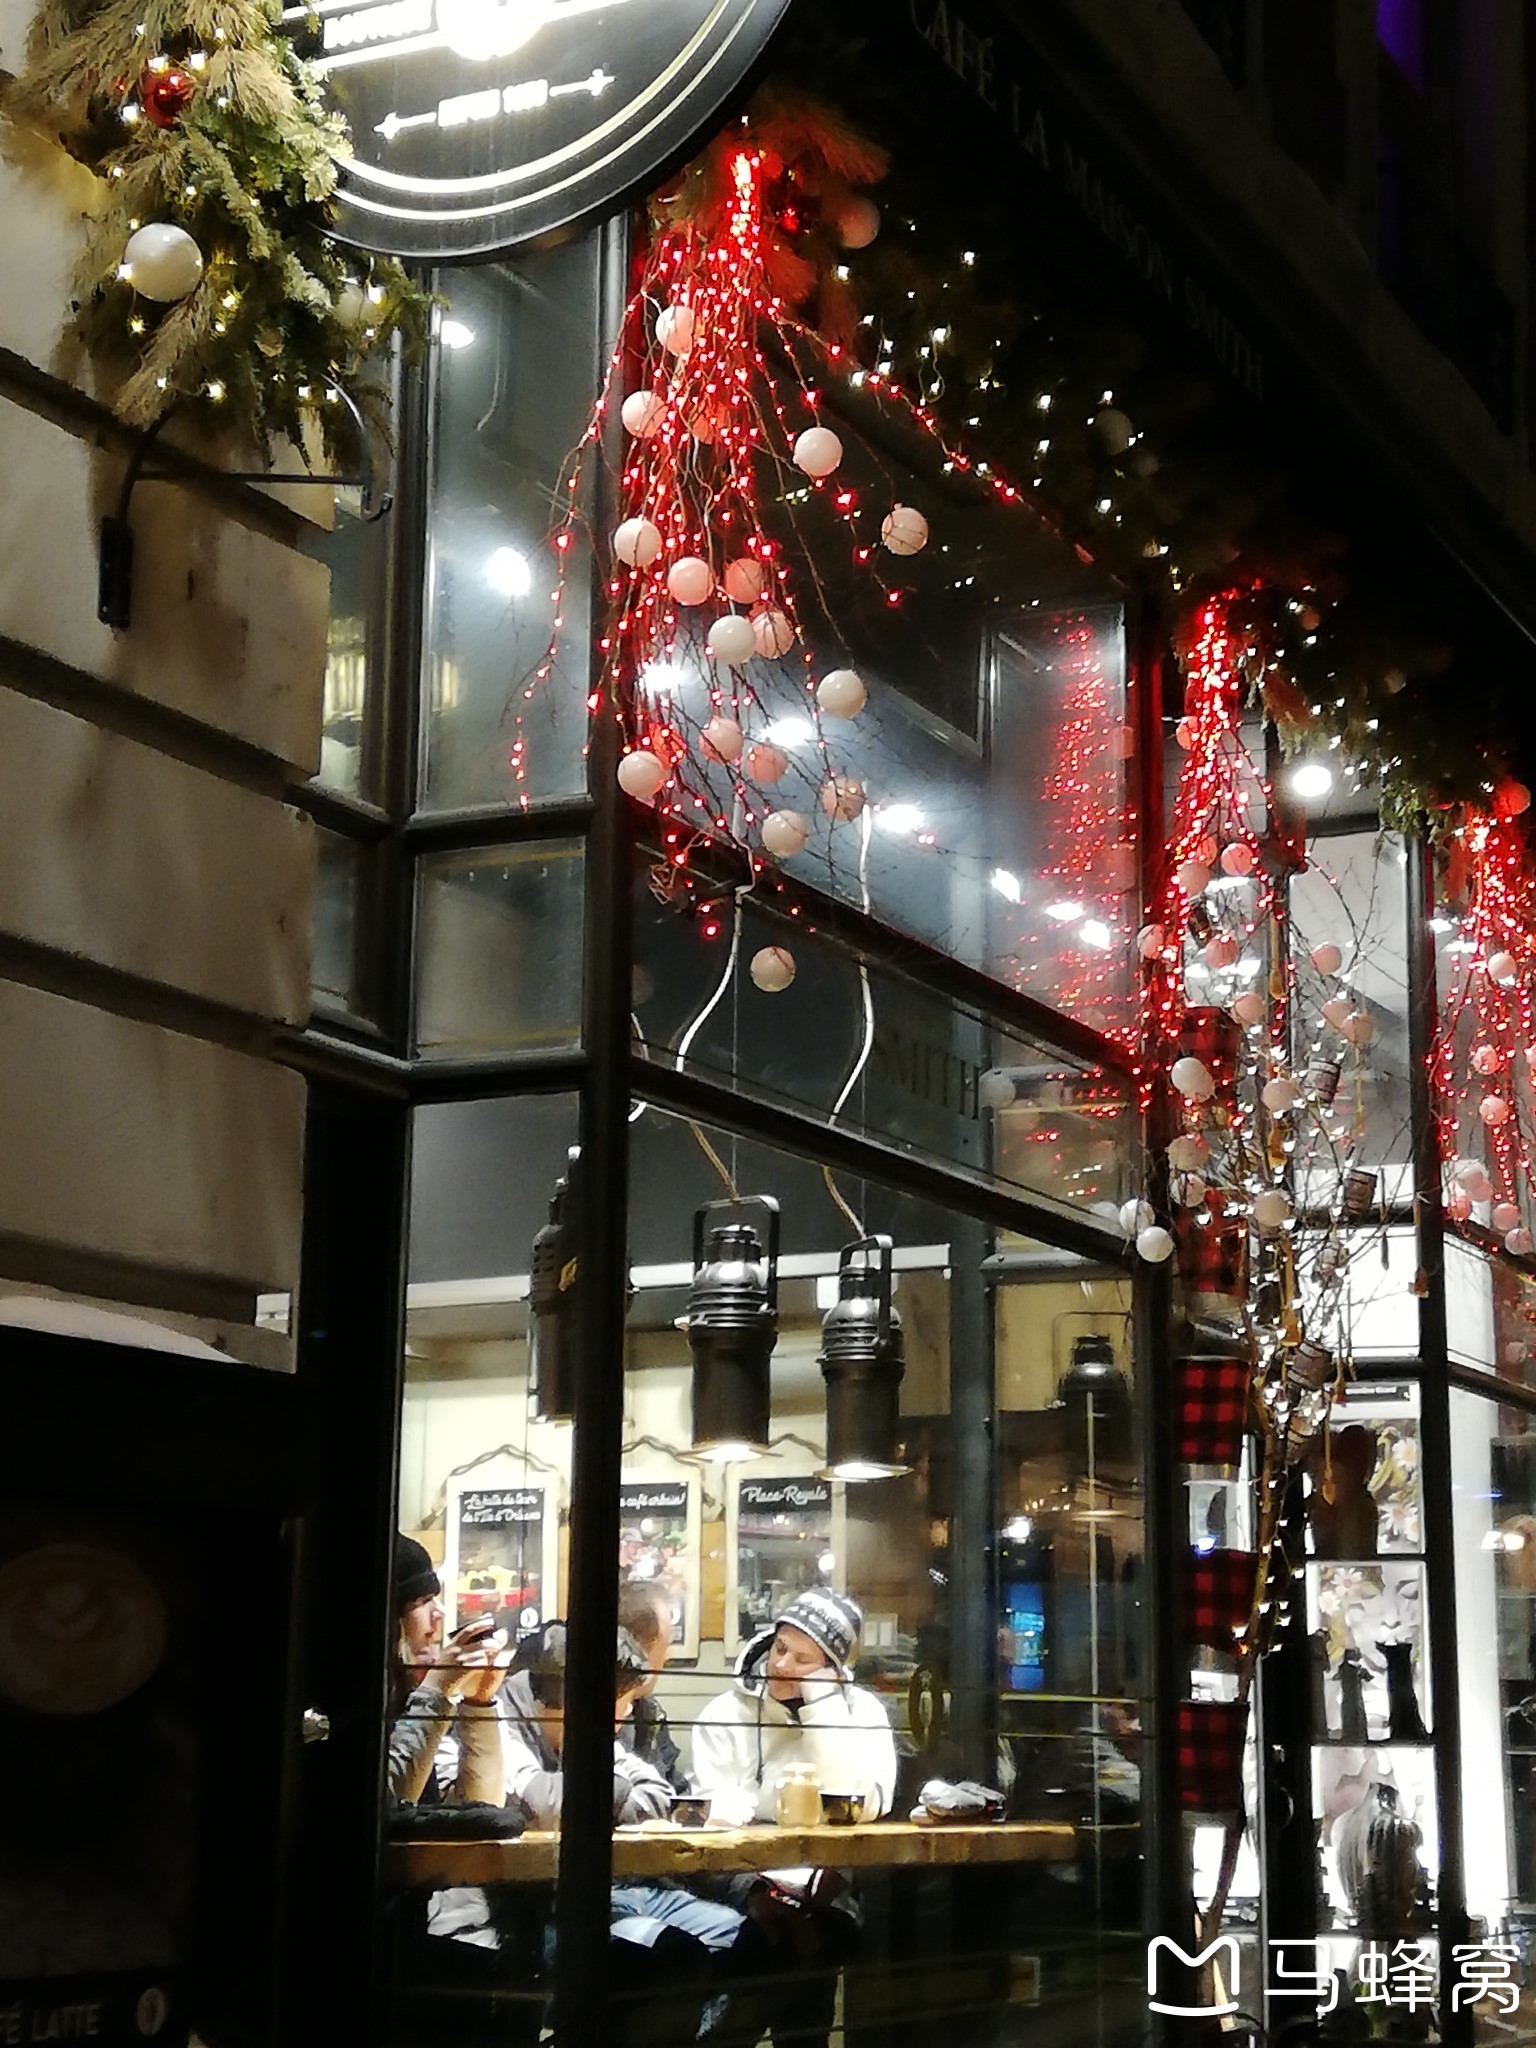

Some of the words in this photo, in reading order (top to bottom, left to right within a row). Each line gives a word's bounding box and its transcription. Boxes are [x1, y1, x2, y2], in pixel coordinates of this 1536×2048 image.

[1011, 79, 1052, 171] LA
[1063, 137, 1173, 305] MAISON
[1184, 275, 1264, 404] SMITH
[31, 2002, 101, 2043] LATTE
